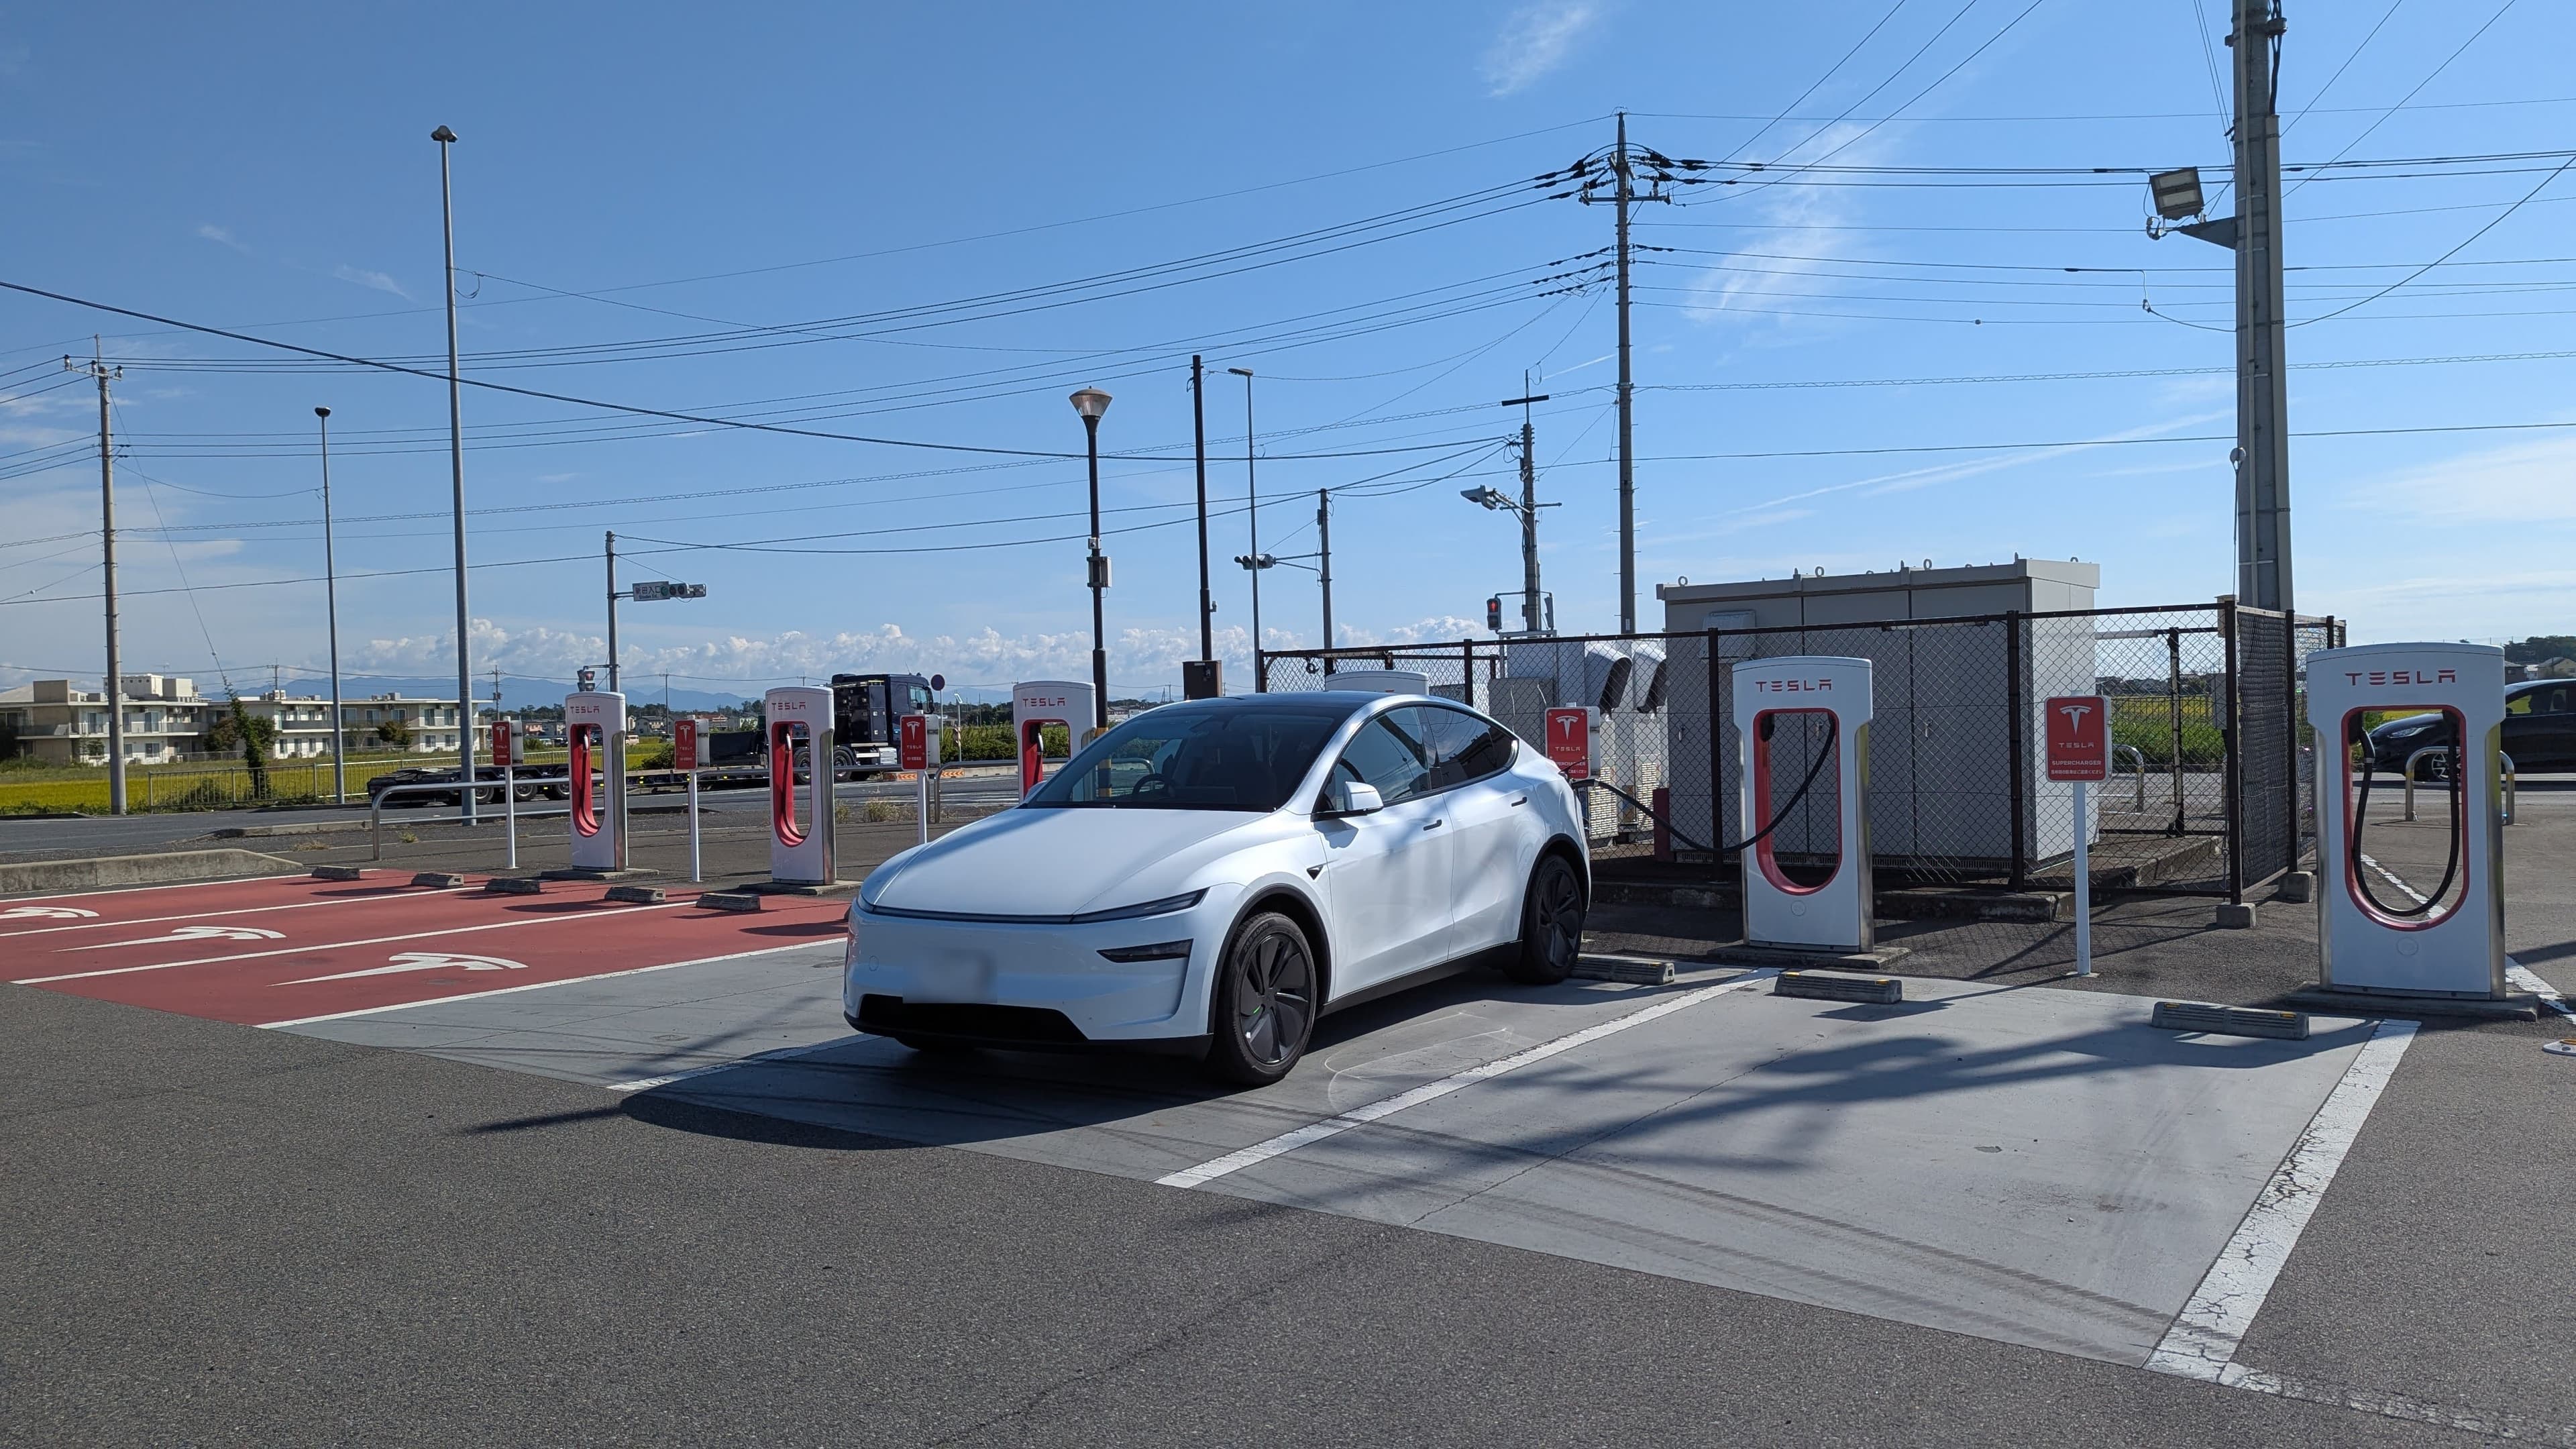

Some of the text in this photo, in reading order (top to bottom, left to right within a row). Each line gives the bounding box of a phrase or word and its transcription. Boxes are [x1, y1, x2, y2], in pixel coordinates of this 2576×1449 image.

[2345, 669, 2456, 686] TESLA
[1755, 679, 1832, 692] TESLA
[771, 702, 806, 710] TESLA
[1022, 697, 1065, 708] TESLA
[570, 705, 600, 714] TESLA
